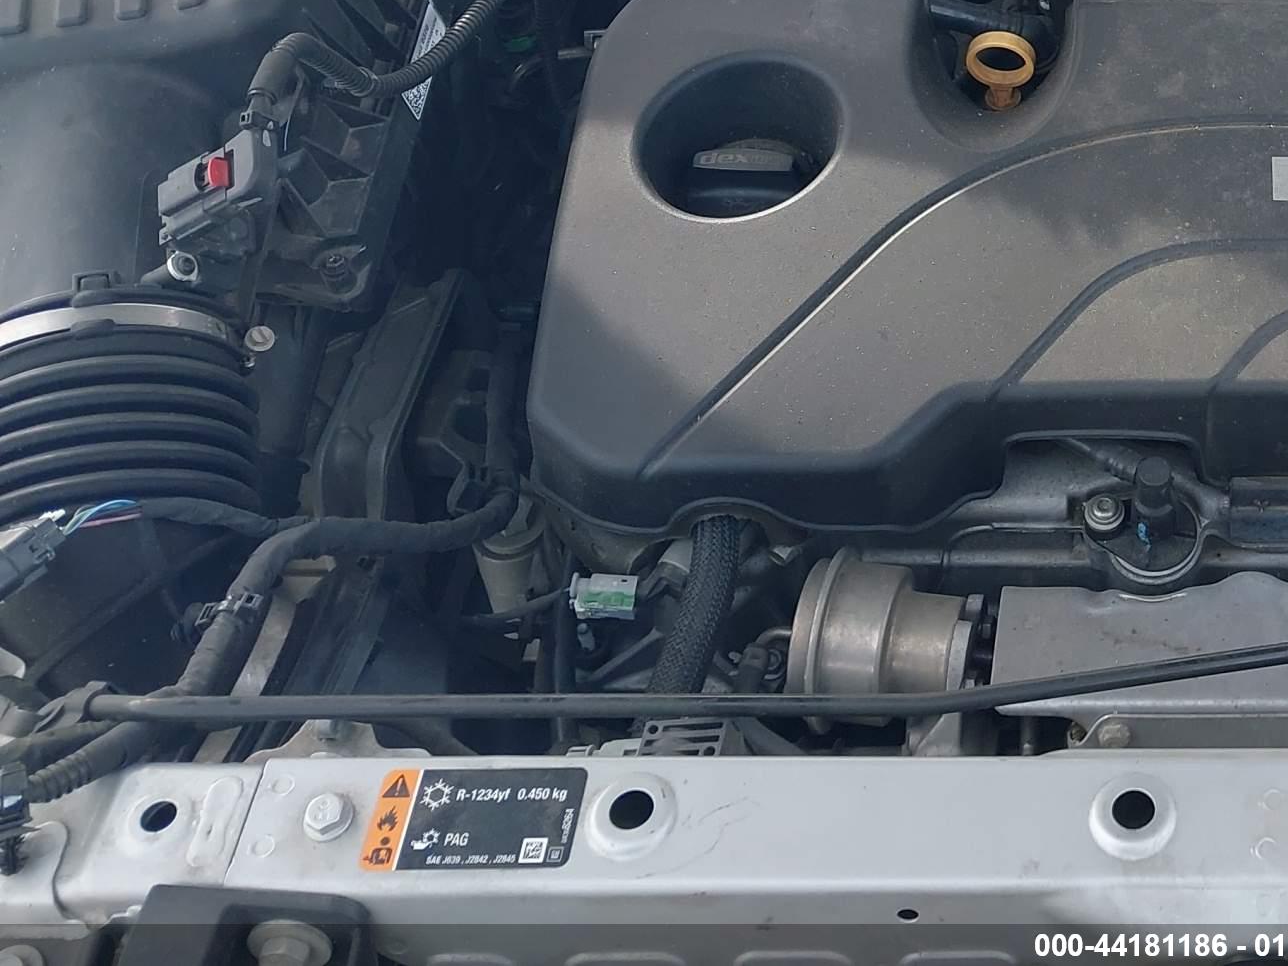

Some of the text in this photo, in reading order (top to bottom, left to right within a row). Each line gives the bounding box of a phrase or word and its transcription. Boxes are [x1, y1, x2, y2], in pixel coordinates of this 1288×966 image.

[455, 788, 568, 803] R-1234yf 0.450 kg
[444, 833, 469, 847] PAG
